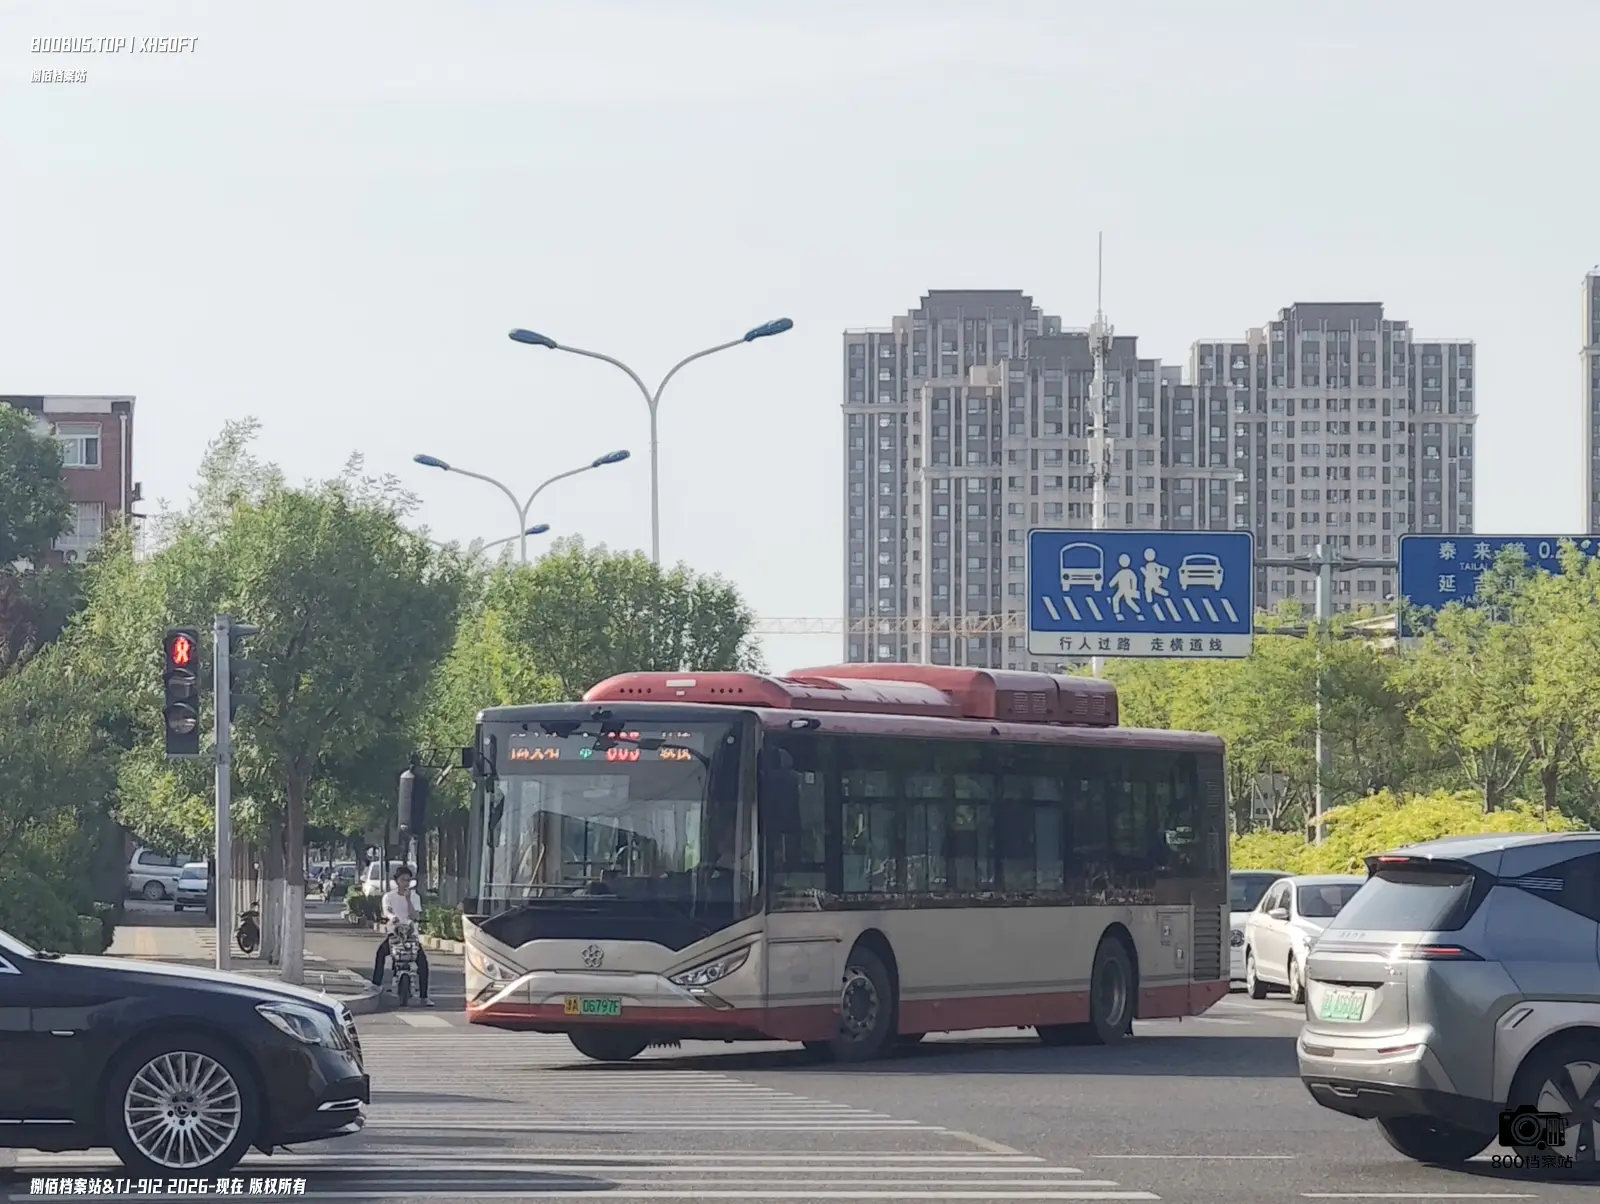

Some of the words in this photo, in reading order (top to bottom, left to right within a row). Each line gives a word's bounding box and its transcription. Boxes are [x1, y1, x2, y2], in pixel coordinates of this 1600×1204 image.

[1059, 636, 1132, 652] 行人过路
[1150, 637, 1223, 652] 走横道线
